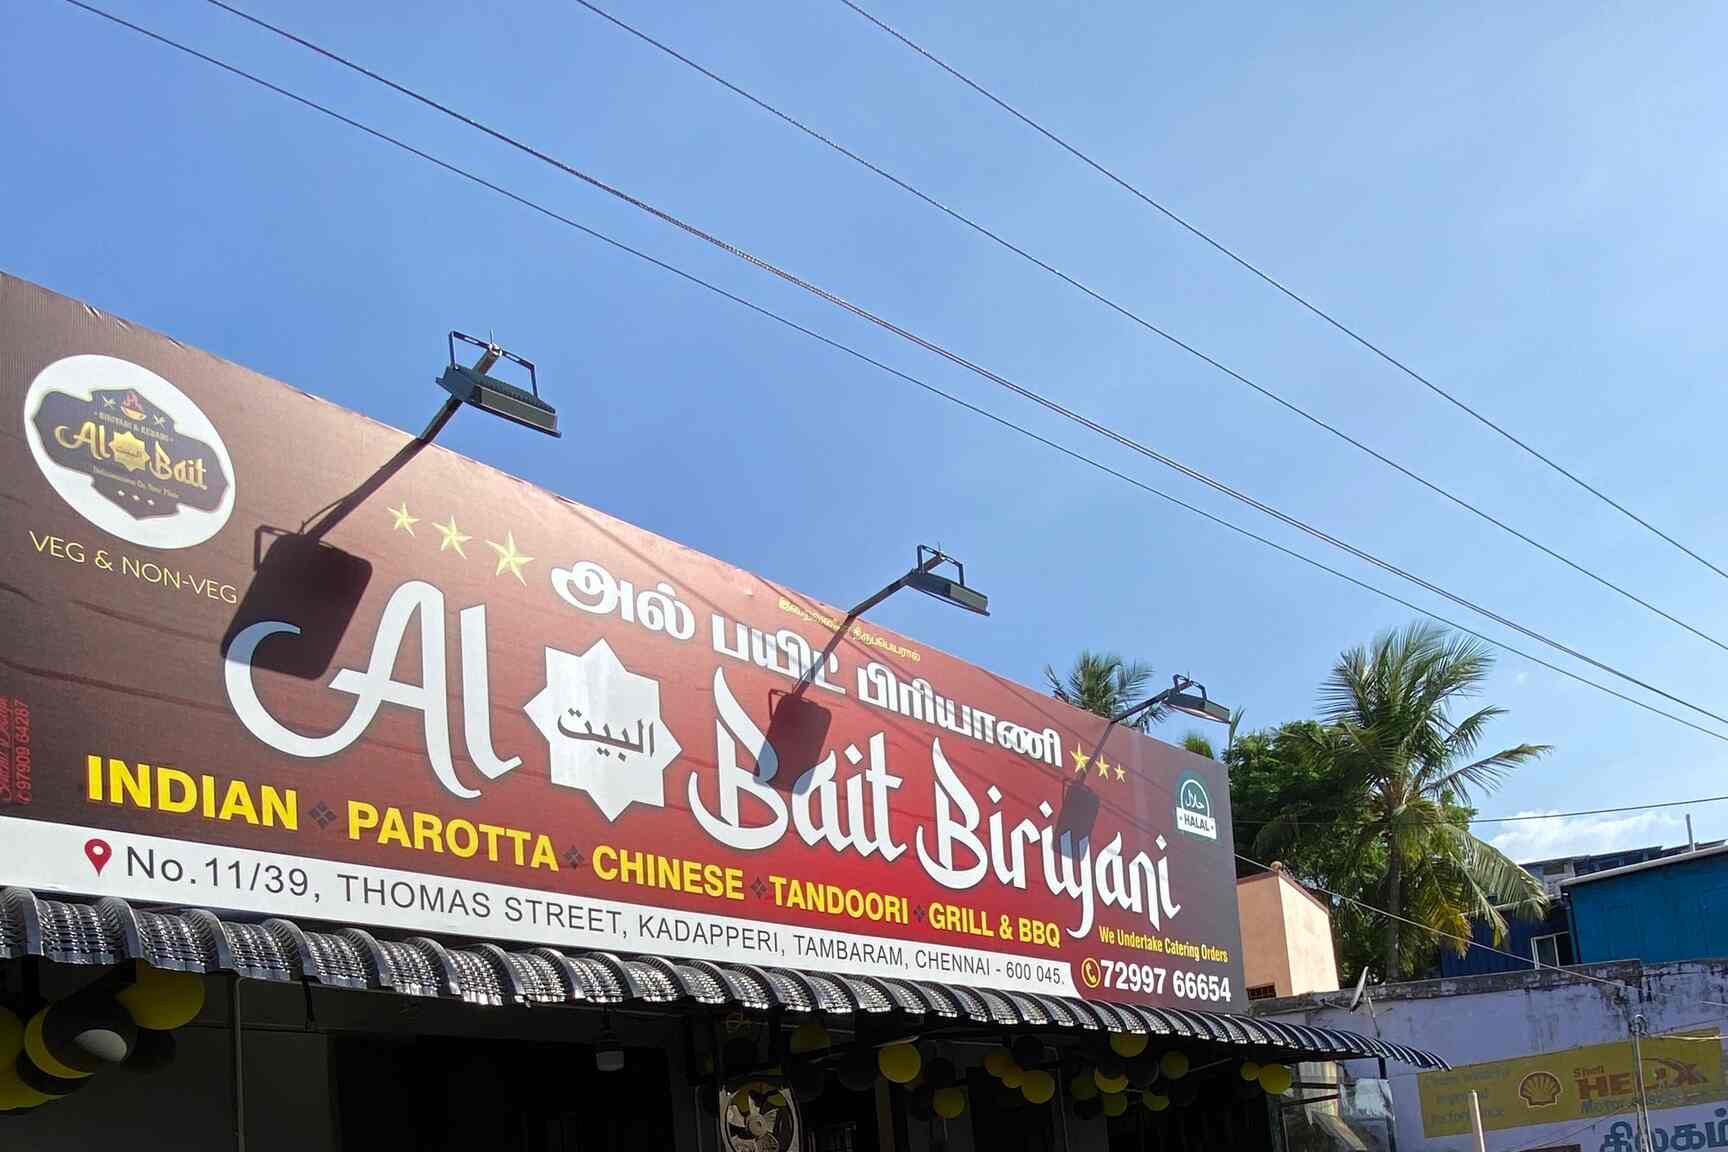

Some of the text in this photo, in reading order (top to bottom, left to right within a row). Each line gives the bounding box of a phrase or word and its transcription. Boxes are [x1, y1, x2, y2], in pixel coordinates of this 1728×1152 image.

[55, 421, 110, 460] Al
[150, 441, 207, 490] Bait
[29, 530, 238, 604] VEG & NON-VEG
[551, 561, 695, 640] அல்
[856, 662, 1062, 768] பிரியாணி
[224, 580, 522, 799] Al
[688, 666, 908, 863] Bait
[916, 737, 1181, 939] Biriyani
[557, 707, 655, 762] البيت
[87, 755, 1060, 948] INDIAN PAROTTA CHINESE TANDOORI GRILL & BBQ
[1184, 813, 1210, 832] HALAL
[337, 874, 491, 918] THOMAS
[505, 897, 627, 938] STREET,
[638, 914, 785, 957] KADAPPERI,
[793, 934, 908, 969] TAMBARAM,
[915, 950, 990, 976] CHENNAI
[1006, 961, 1031, 981] 600
[1099, 926, 1228, 962] We Undertake Catering Orders
[1100, 960, 1232, 1002] 72997 66654
